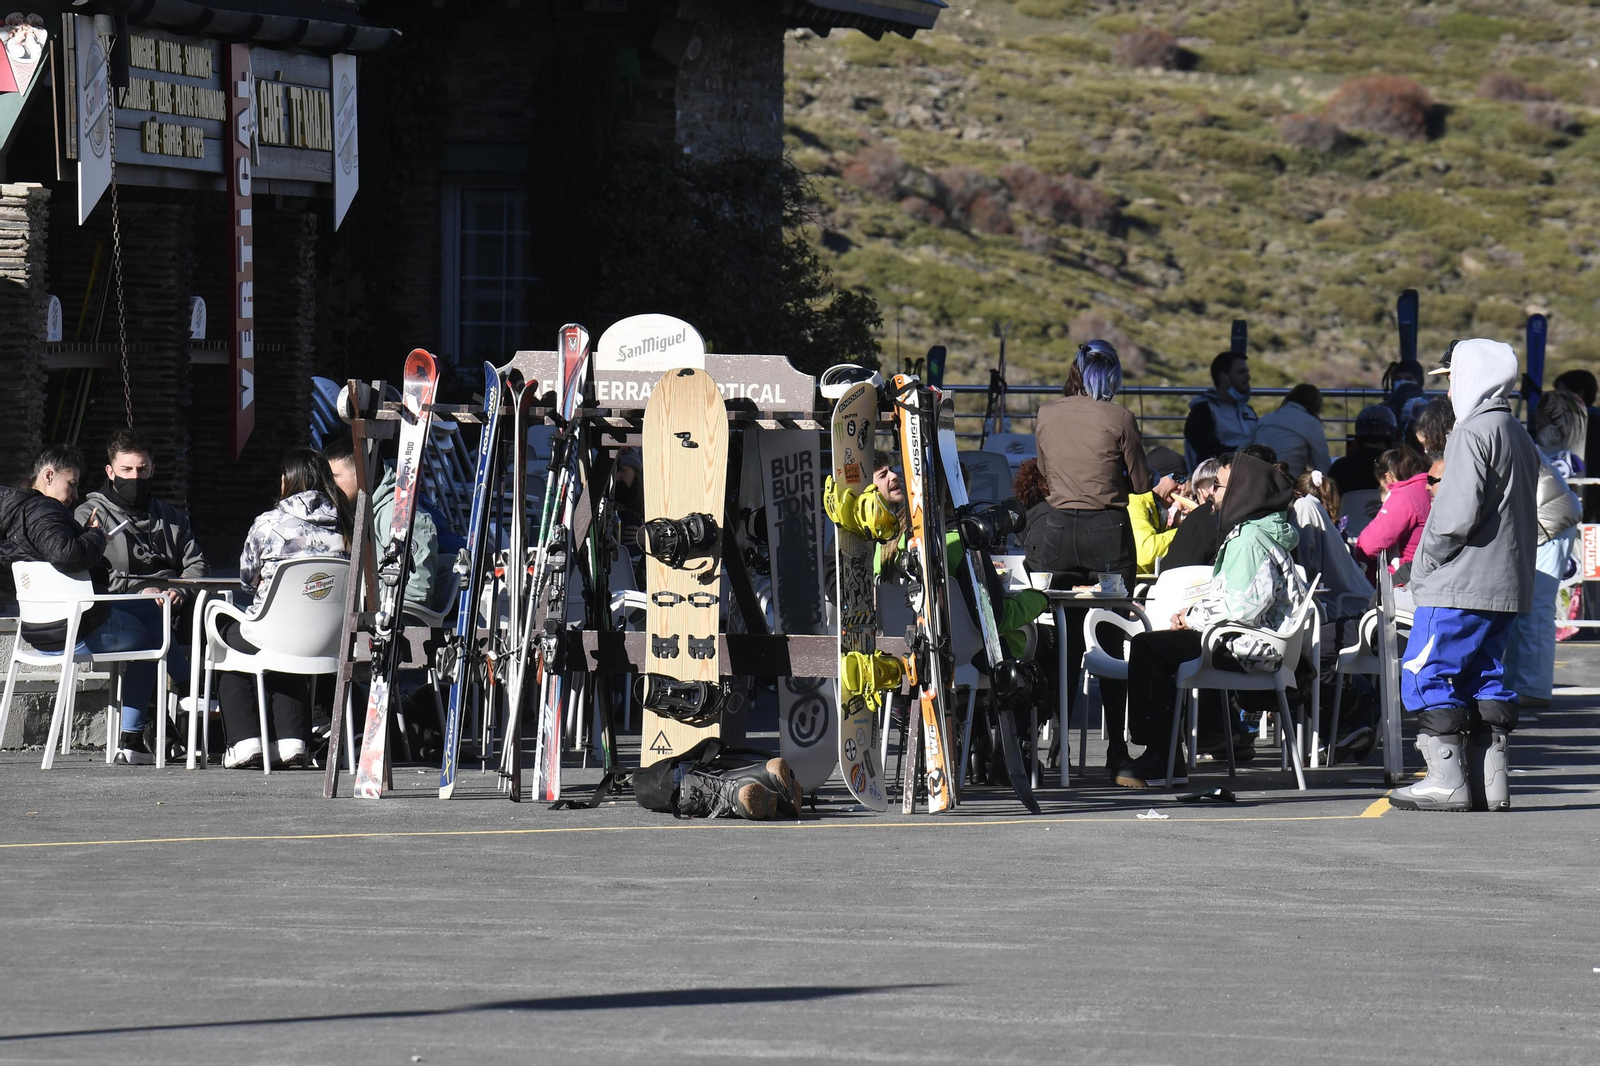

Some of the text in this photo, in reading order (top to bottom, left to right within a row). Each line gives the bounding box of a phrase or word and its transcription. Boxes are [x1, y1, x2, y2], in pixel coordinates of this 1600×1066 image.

[290, 86, 332, 151] TERRAZA
[235, 71, 254, 411] VERTICAL
[770, 450, 814, 479] BUR
[772, 471, 815, 499] BUR
[773, 491, 815, 520] TON
[1585, 527, 1596, 577] VERTICAL
